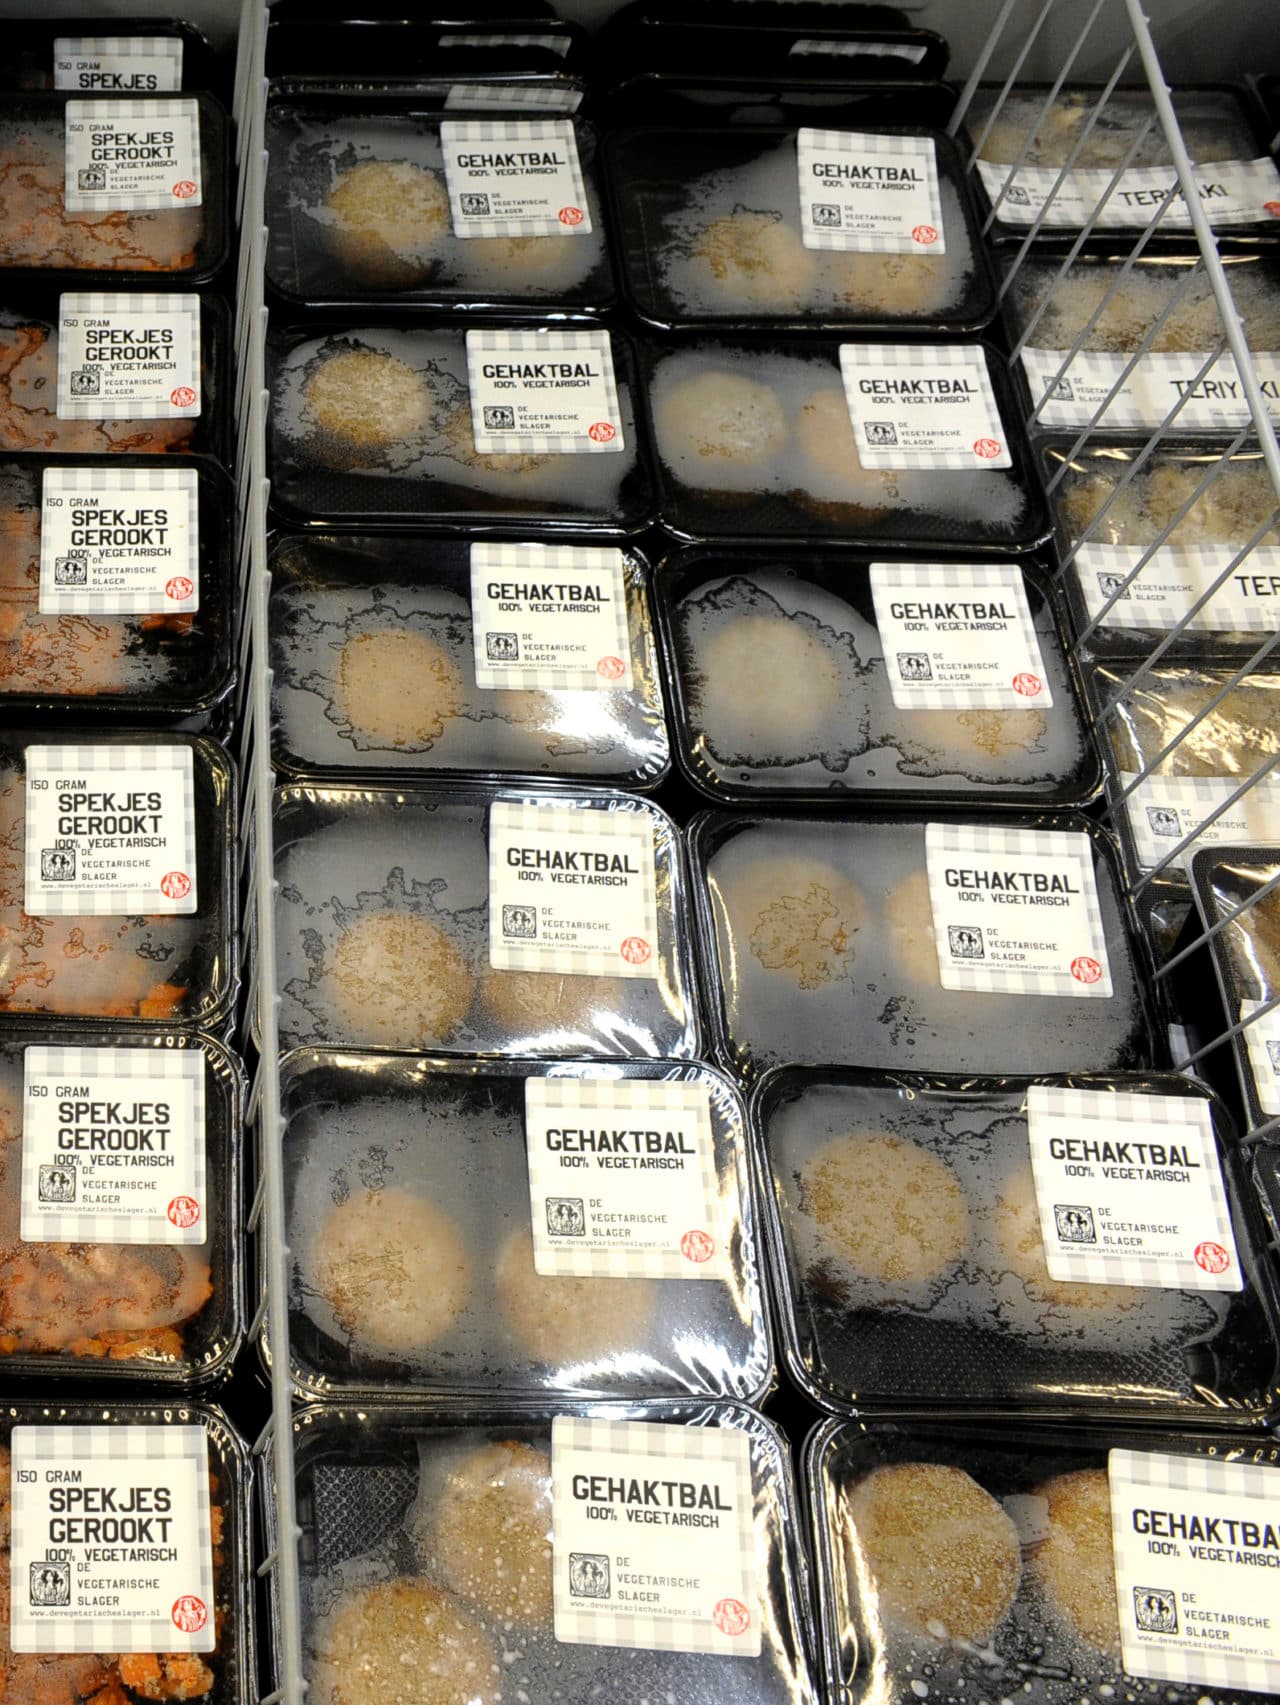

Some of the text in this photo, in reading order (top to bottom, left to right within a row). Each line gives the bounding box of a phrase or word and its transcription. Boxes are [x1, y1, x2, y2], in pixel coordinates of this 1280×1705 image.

[76, 62, 100, 70] GRAM
[79, 73, 157, 90] SPEKJES
[89, 124, 114, 132] GRAM
[91, 131, 174, 146] SPEKJES
[91, 146, 174, 161] GEROOKT
[457, 152, 566, 168] GEHAKTBAL
[115, 160, 178, 169] VEGETARISCH
[495, 168, 558, 176] VEGETARISCH
[812, 163, 924, 182] GEHAKTBAL
[849, 181, 915, 191] VEGETARISCH
[86, 329, 173, 345] SPEKJES
[85, 346, 174, 361] GEROOKT
[82, 362, 177, 372] 100% VEGETARISCH
[482, 363, 600, 378] GEHAKTBAL
[494, 380, 590, 389] 100% VEGETARISCH
[859, 379, 978, 394] GEHAKTBAL
[1169, 380, 1280, 400] TERIYKI
[901, 395, 970, 404] VEGETARISCH
[69, 498, 99, 507] GRAM
[71, 509, 168, 527] SPEKJES
[71, 528, 168, 546] GEROOKT
[67, 547, 172, 558] 100% VEGETARISCH
[487, 582, 611, 602] GEHAKTBAL
[498, 602, 600, 613] 100% VEGETARISCH
[890, 602, 1016, 620] GEHAKTBAL
[904, 622, 1008, 631] 100% VEGETARISCH
[30, 780, 87, 790] 150 GRAM
[58, 792, 162, 812] SPEKJES
[58, 815, 163, 835] GEROOKT
[55, 837, 167, 850] 100% VEGETARISCH
[81, 860, 151, 869] VEGETARISCHE
[507, 847, 639, 874] GEHAKTBAL
[81, 873, 117, 881] SLAGER
[517, 870, 628, 887] 100% VEGETARISCH
[945, 868, 1080, 894] GEHAKTBAL
[958, 891, 1070, 907] 100% VEGETARISCH
[542, 920, 611, 931] VEGETARISCHE
[542, 931, 577, 941] SLAGER
[988, 940, 1059, 951] VEGETARISCHE
[990, 952, 1026, 961] SLAGER
[28, 1085, 90, 1098] 150 GRAM
[58, 1102, 170, 1125] SPEKJES
[58, 1128, 171, 1151] GEROOKT
[546, 1128, 696, 1155] GEHAKTBAL
[1049, 1138, 1201, 1168] GEHAKTBAL
[53, 1154, 175, 1167] 100% VEGETARISCH
[560, 1155, 684, 1170] 100% VEGETARISCH
[82, 1166, 95, 1175] DE
[1064, 1164, 1191, 1183] 100% VEGETARISCH
[82, 1181, 157, 1190] VEGETARISCHE
[82, 1195, 121, 1204] SLAGER
[589, 1199, 603, 1208] DE
[590, 1214, 669, 1223] VEGETARISCHE
[1098, 1207, 1112, 1217] DE
[592, 1228, 631, 1238] SLAGER
[1100, 1222, 1179, 1234] VEGETARISCHE
[1103, 1236, 1143, 1246] SLAGER
[16, 1470, 82, 1483] 150 GRAM
[572, 1474, 732, 1511] GEHAKTBAL
[48, 1487, 171, 1513] SPEKJES
[586, 1506, 719, 1528] 100% VEGETARISCH
[48, 1518, 173, 1544] GEROOKT
[1132, 1508, 1280, 1550] GEHAKTBA
[45, 1548, 177, 1562] 100% VEGETARISCH
[1148, 1540, 1181, 1557] 100%
[76, 1562, 91, 1572] DE
[616, 1557, 630, 1567] DE
[77, 1579, 160, 1589] VEGETARISCHE
[617, 1573, 701, 1589] VEGETARISCHE
[77, 1596, 120, 1606] SLAGER
[618, 1590, 661, 1603] SLAGER
[1182, 1592, 1197, 1603] DE
[1183, 1609, 1271, 1629] VEGETARISCHE
[1185, 1626, 1230, 1641] SLAGER
